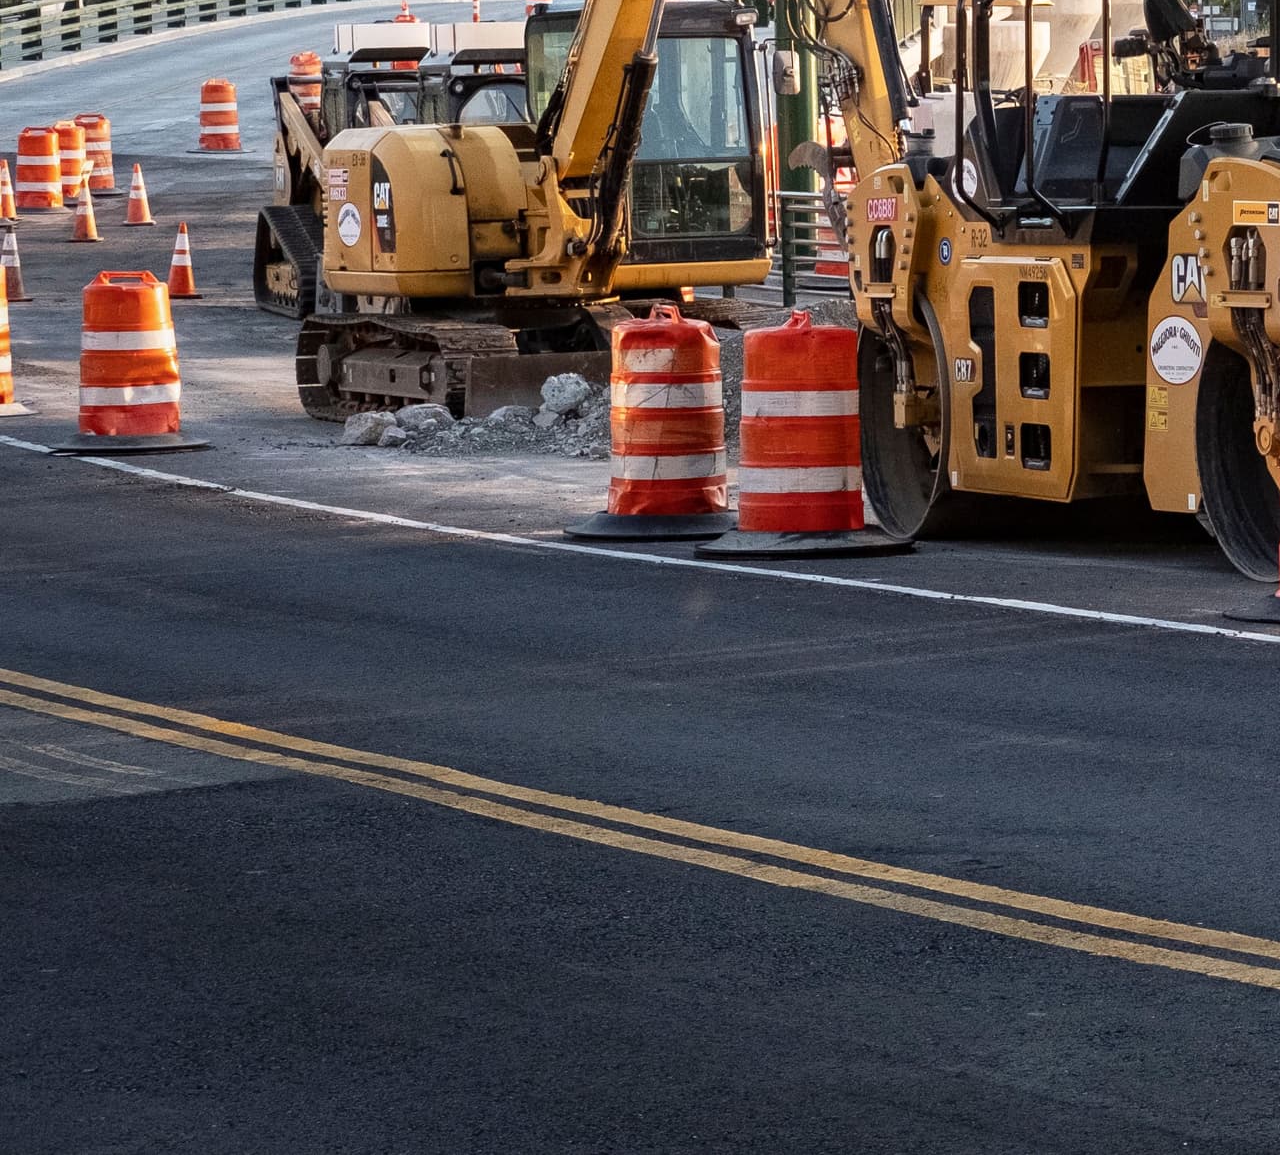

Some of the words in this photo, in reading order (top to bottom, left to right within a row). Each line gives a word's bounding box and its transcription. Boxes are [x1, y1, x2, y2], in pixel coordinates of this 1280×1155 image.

[374, 182, 390, 210] CAT
[1268, 207, 1278, 220] CAT
[971, 229, 988, 248] R-32
[1152, 326, 1177, 356] MAGGIORA
[1179, 327, 1201, 357] GHILOTTI
[955, 359, 972, 382] CB7
